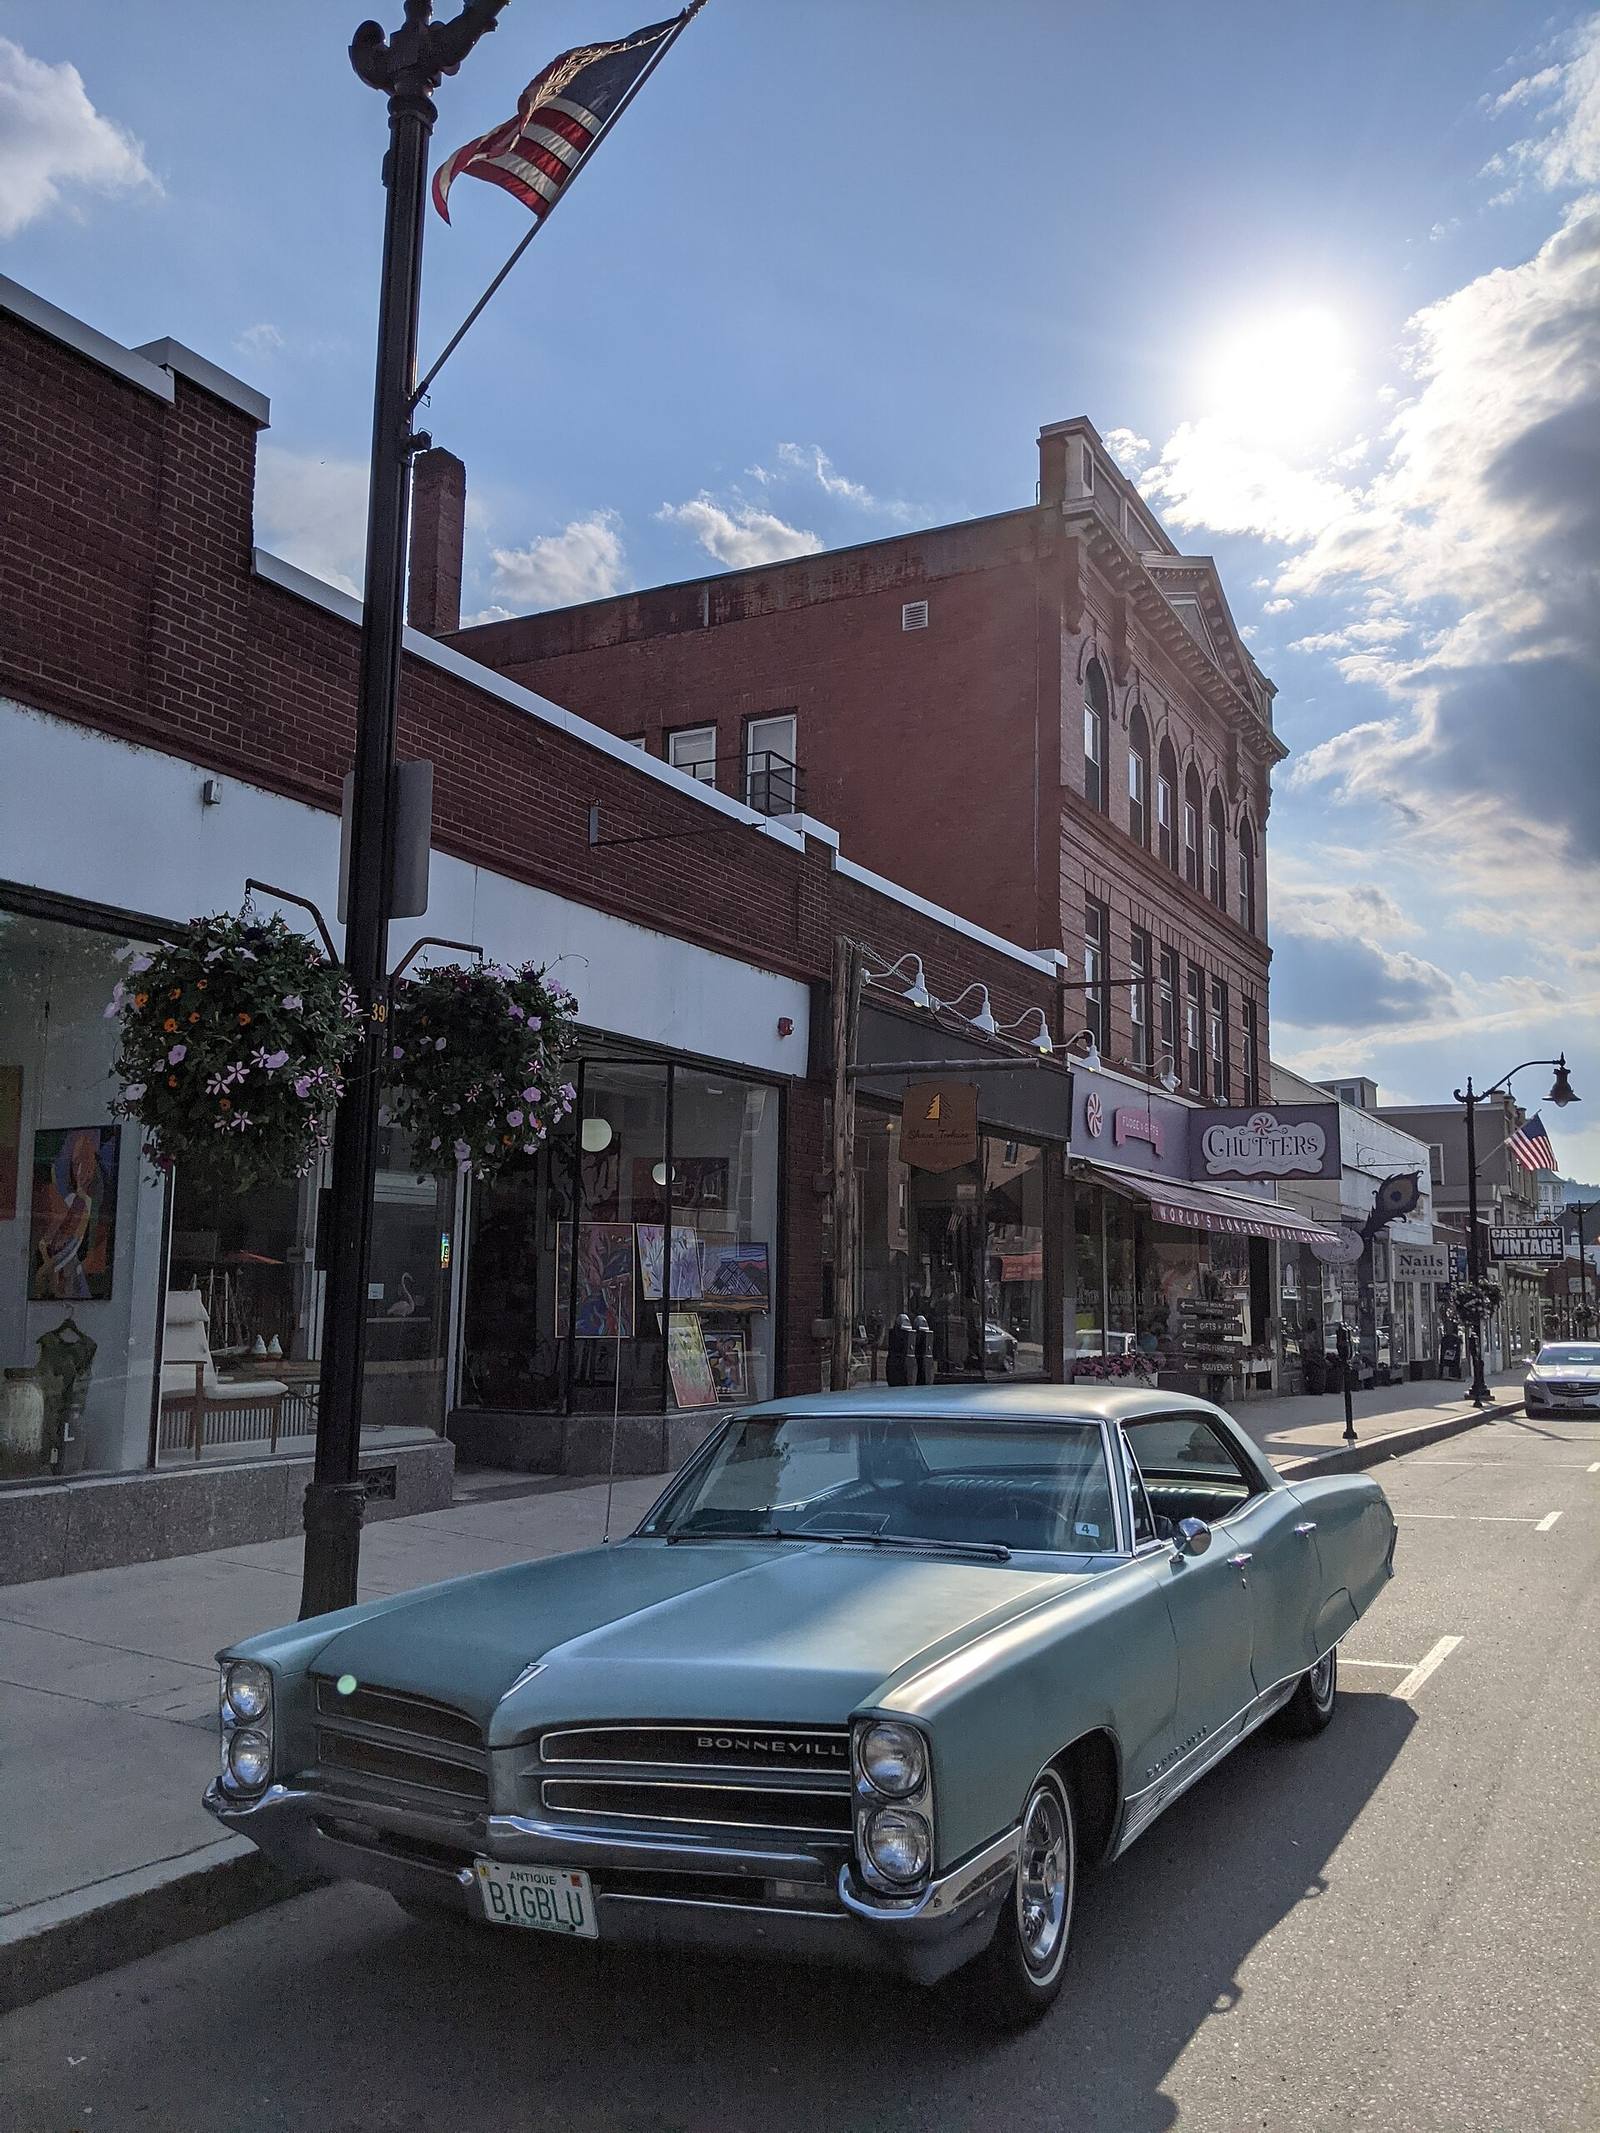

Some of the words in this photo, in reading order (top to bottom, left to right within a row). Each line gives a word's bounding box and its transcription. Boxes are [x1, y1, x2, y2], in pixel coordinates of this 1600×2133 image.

[371, 1003, 386, 1023] 39
[1208, 1129, 1318, 1158] CHUTTERS
[1160, 1206, 1212, 1228] WORLD'S
[1491, 1229, 1526, 1238] CASH
[1528, 1229, 1560, 1238] ONLY
[1492, 1239, 1562, 1255] VINTAGE
[1399, 1254, 1443, 1267] Nails
[1200, 1322, 1217, 1331] GIFTS
[1223, 1322, 1235, 1331] ART
[1081, 1524, 1090, 1534] 4
[510, 1871, 556, 1885] ANTIQUE
[488, 1881, 585, 1927] BIGBLU
